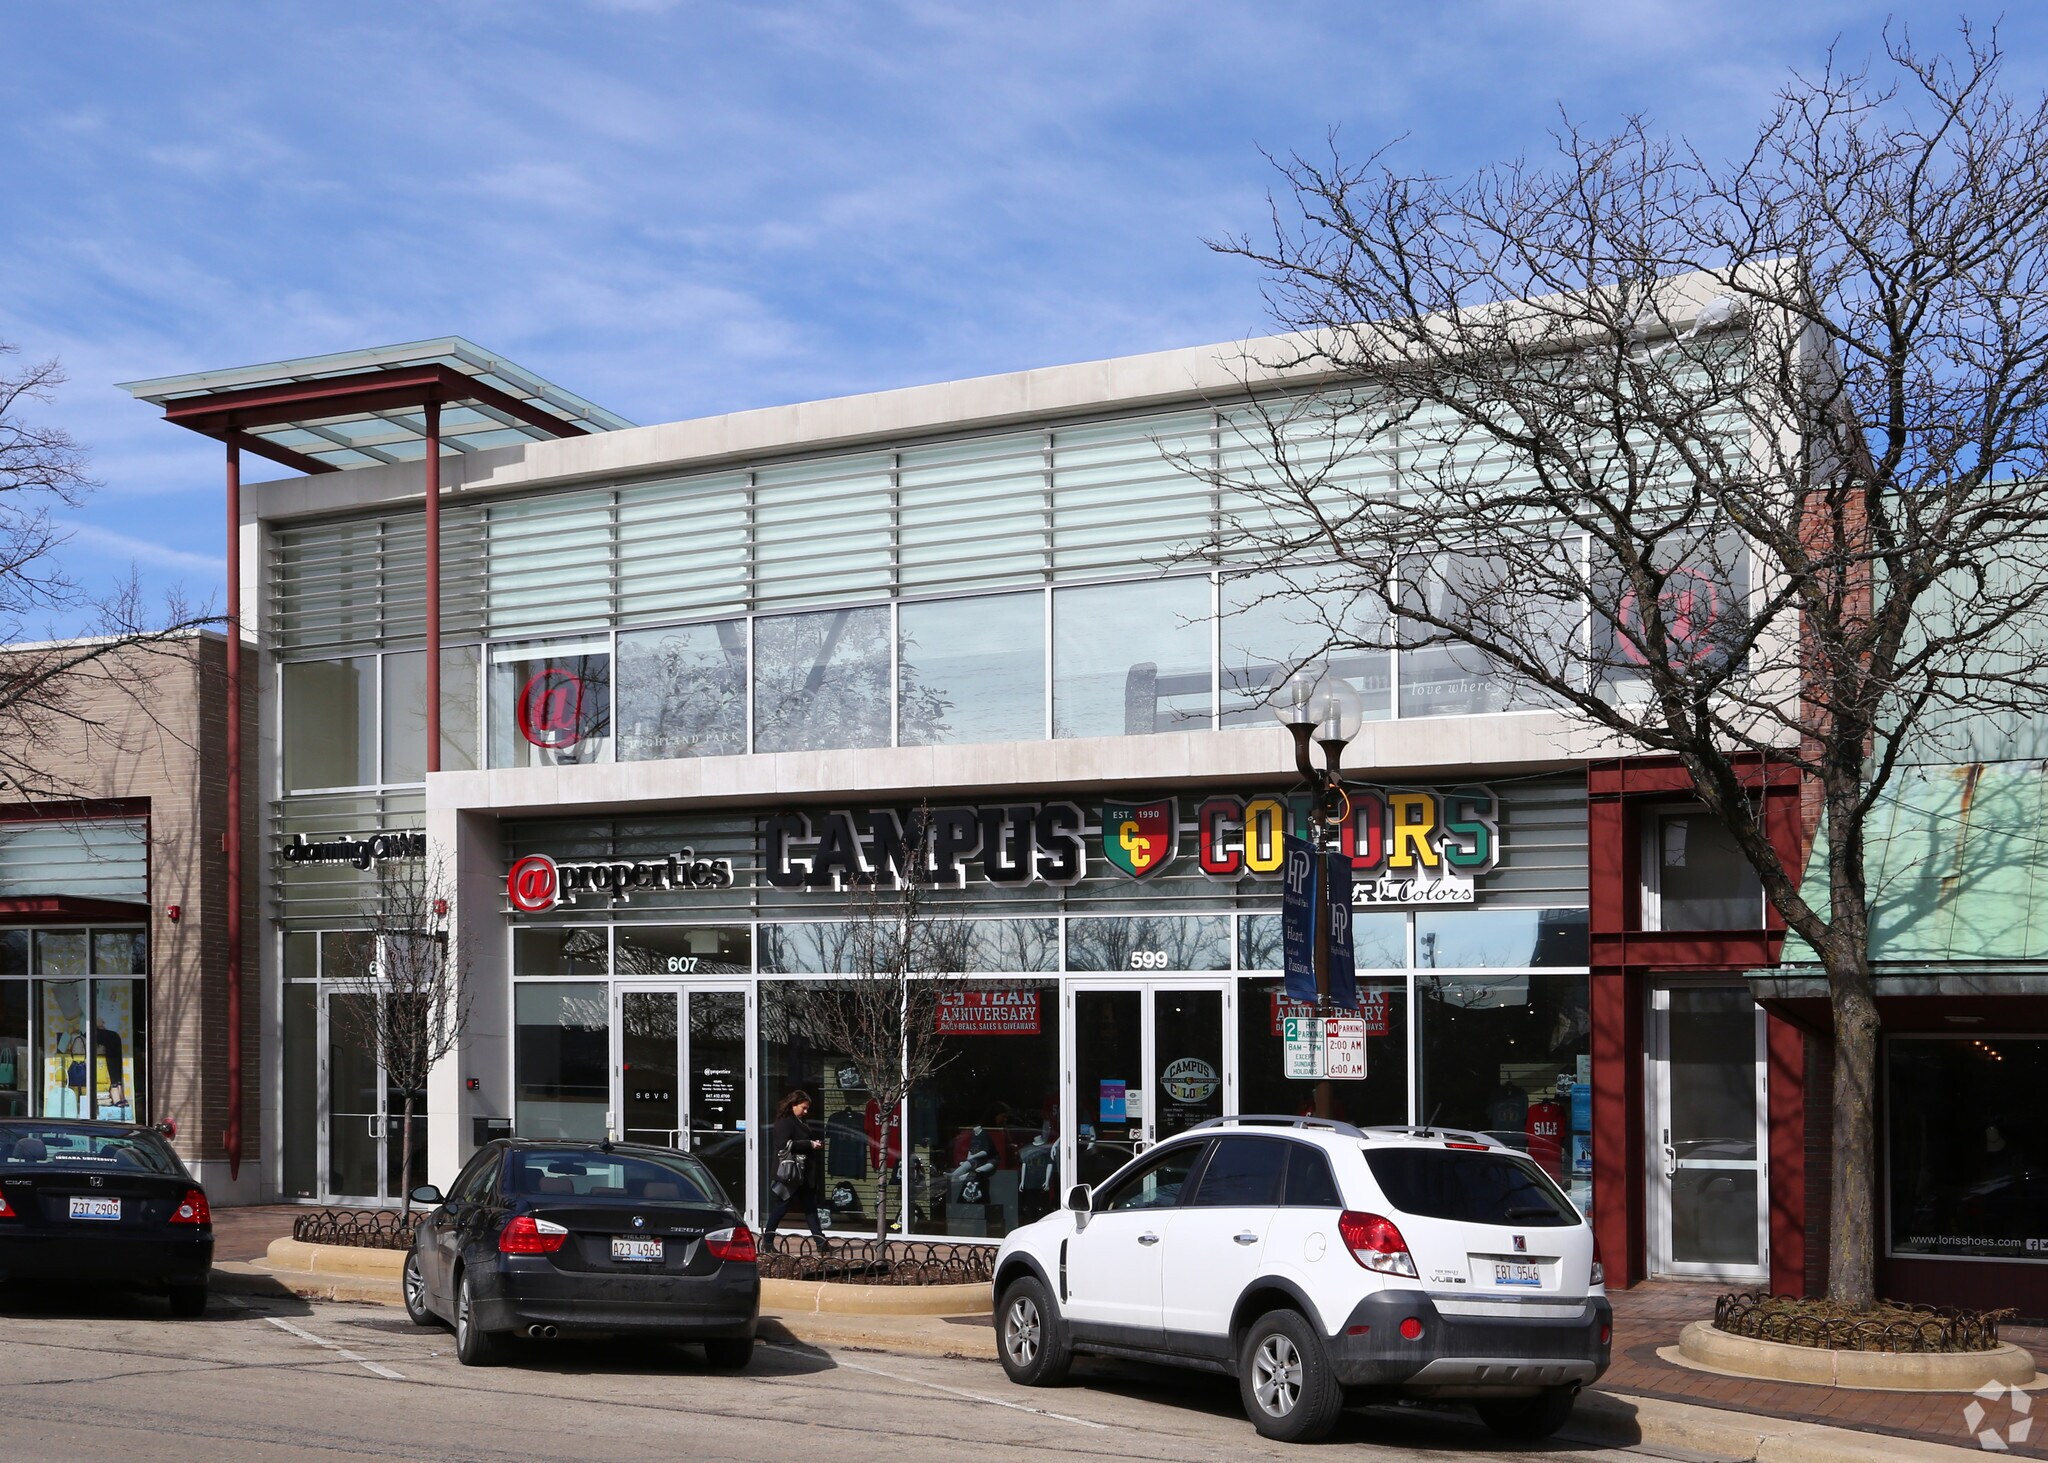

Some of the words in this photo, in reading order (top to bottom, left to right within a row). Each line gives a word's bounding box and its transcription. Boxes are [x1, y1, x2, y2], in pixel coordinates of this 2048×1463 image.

[1412, 682, 1442, 696] love
[1448, 679, 1491, 694] where
[629, 736, 699, 749] HIGHLAND
[706, 732, 740, 743] PARK
[1112, 811, 1135, 820] EST.
[1138, 809, 1160, 819] 1990
[766, 803, 1087, 891] CAMPUS
[507, 848, 734, 912] @properties
[1397, 878, 1472, 902] Colors
[667, 956, 698, 974] 607
[1130, 951, 1168, 969] 599
[941, 1007, 1037, 1021] ANNIVERSARY
[979, 1022, 996, 1030] SALES
[1286, 1022, 1296, 1038] 2
[1305, 1021, 1316, 1029] HR
[1327, 1022, 1338, 1035] NO
[1339, 1025, 1363, 1033] PARKING
[1298, 1031, 1323, 1039] PARKING
[1330, 1041, 1347, 1050] 2:00
[1351, 1041, 1362, 1050] AM
[1341, 1053, 1351, 1062] TO
[1169, 1060, 1210, 1077] CAMPUS
[1330, 1064, 1348, 1074] 6:00
[1351, 1064, 1362, 1074] AM
[1170, 1083, 1210, 1099] COLORS
[874, 1113, 899, 1127] SE
[1533, 1121, 1558, 1136] SALE
[72, 1202, 90, 1214] Z37
[95, 1202, 119, 1215] 2909
[1909, 1235, 2021, 1247] www.lorisshoes.com
[613, 1243, 631, 1256] A23
[637, 1243, 662, 1257] 4965
[1429, 1275, 1453, 1283] VUE
[1495, 1264, 1511, 1280] E87
[1517, 1265, 1539, 1281] 9546
